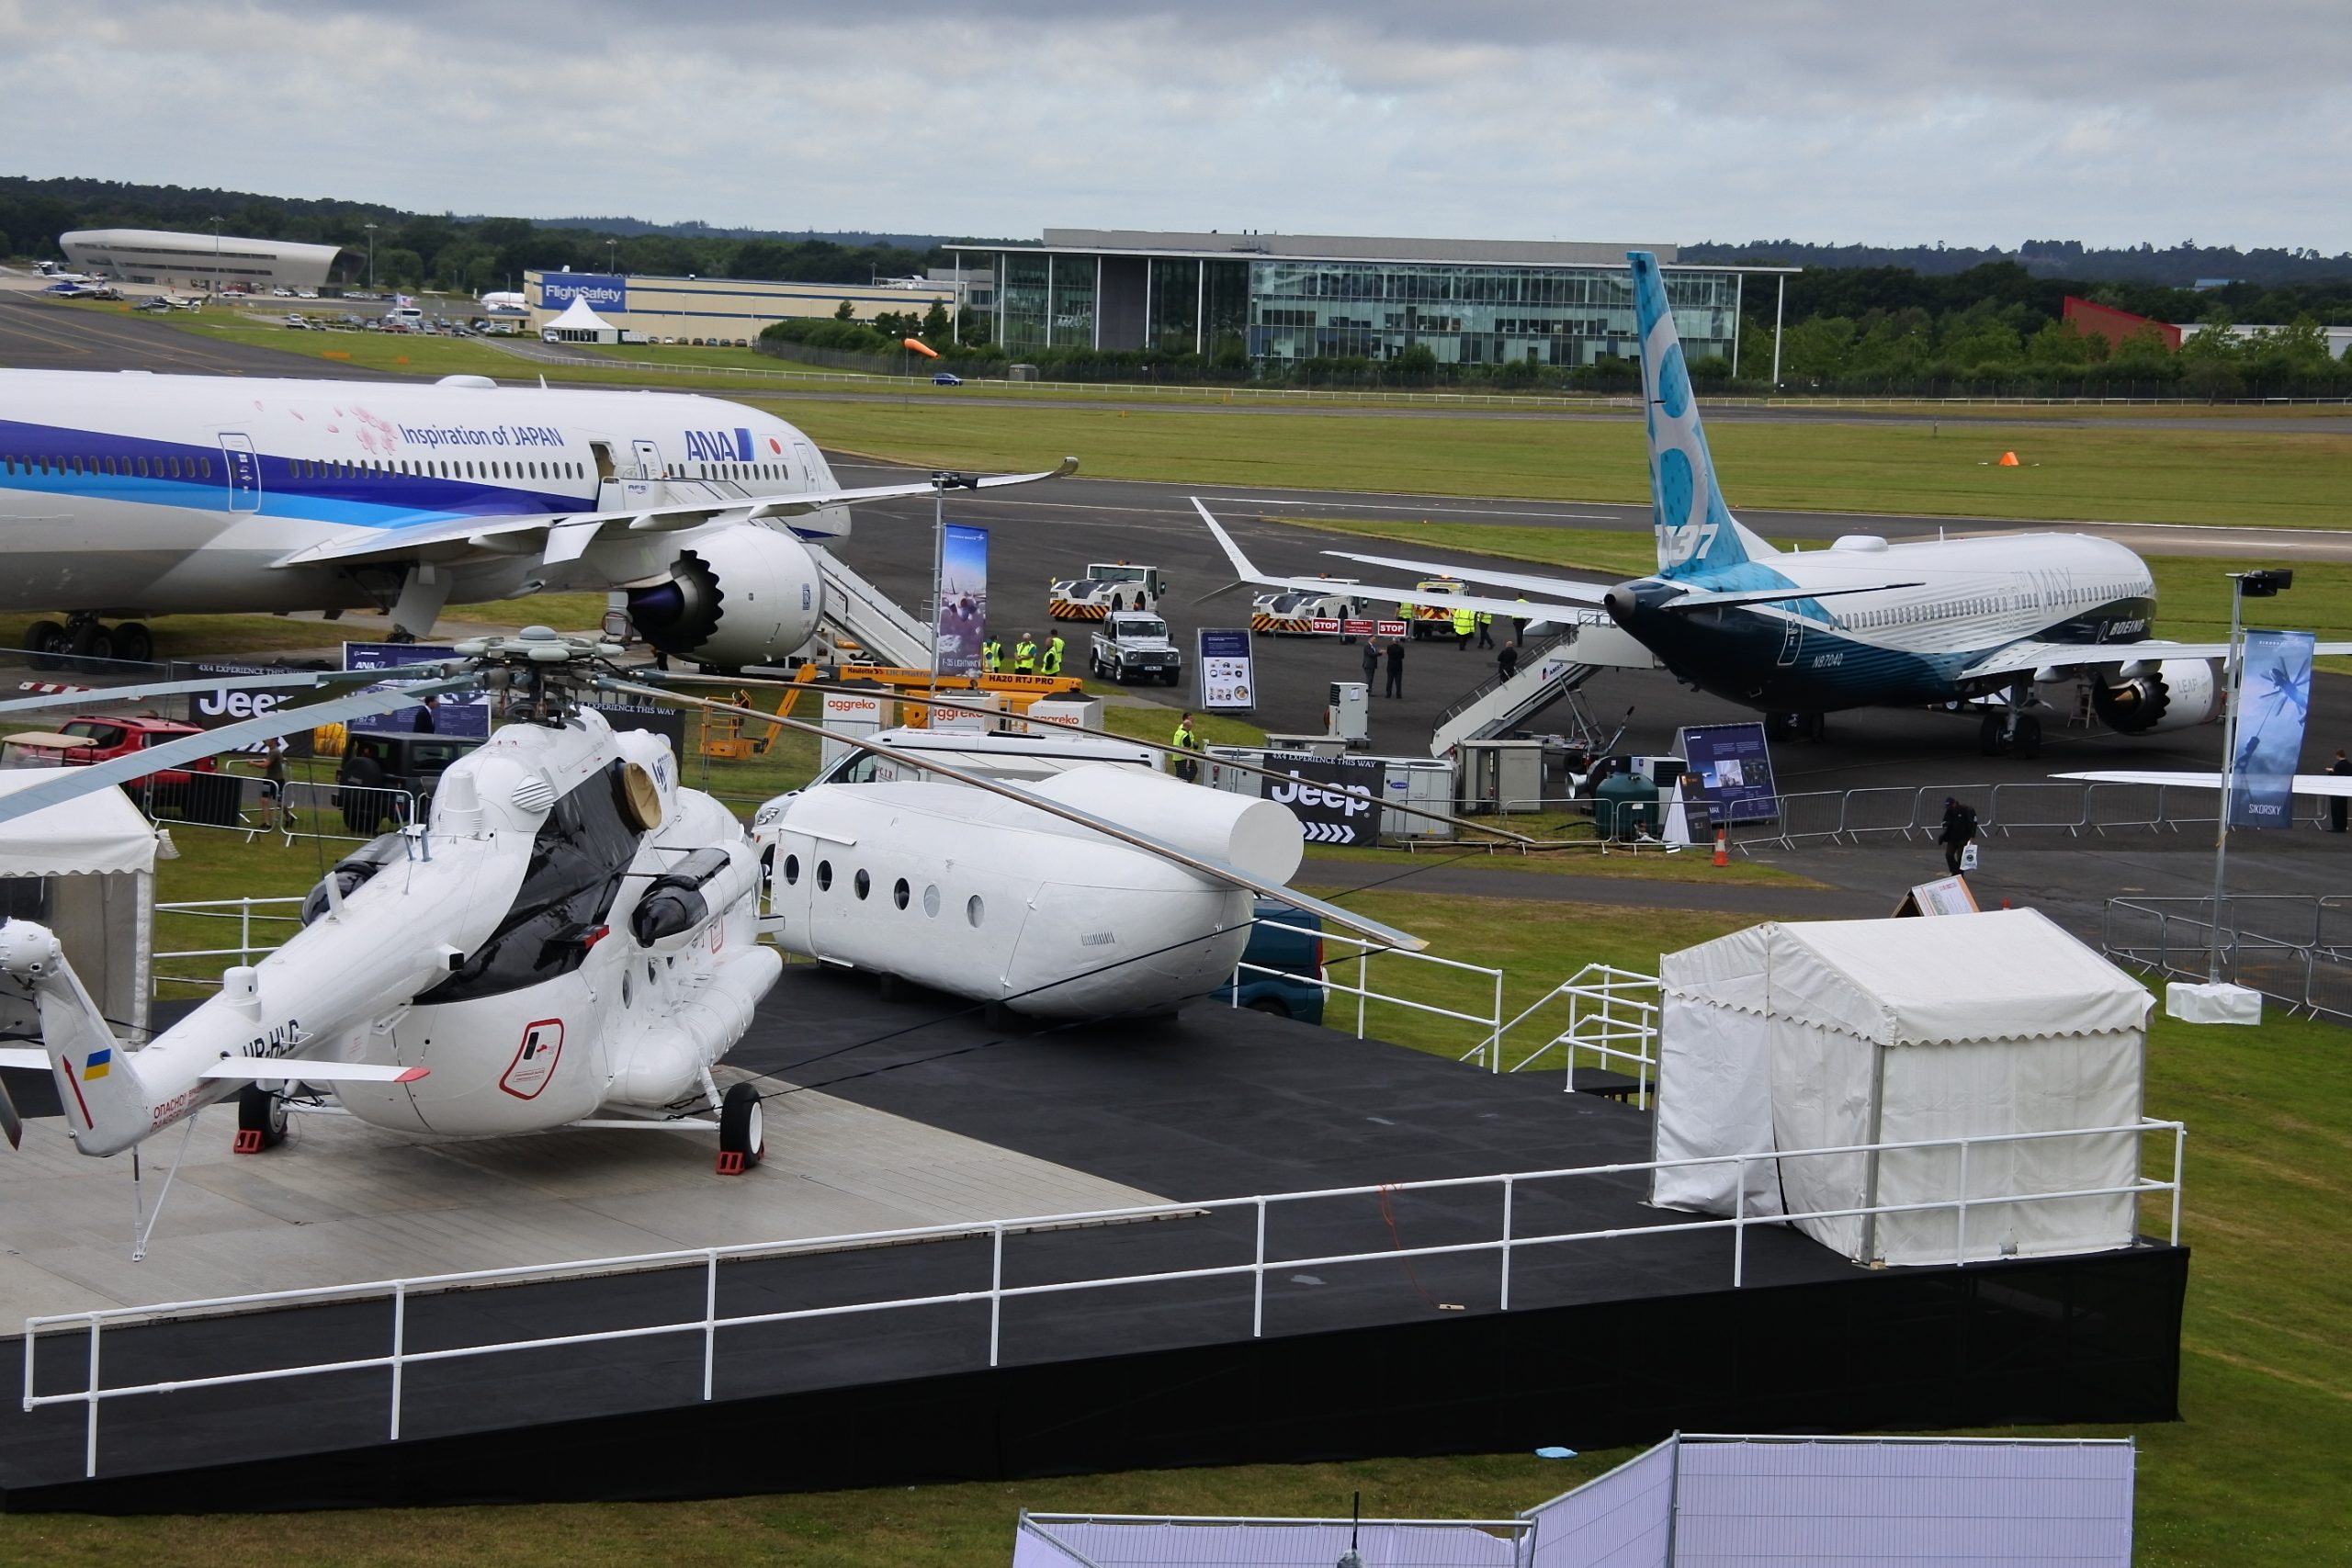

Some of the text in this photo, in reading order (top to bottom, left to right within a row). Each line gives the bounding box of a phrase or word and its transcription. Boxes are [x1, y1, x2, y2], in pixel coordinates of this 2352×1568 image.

[546, 285, 621, 302] FlightSafety
[398, 423, 565, 449] Inspiration of JAPAN
[684, 430, 738, 461] ANA
[1314, 621, 1338, 629] STOP
[2109, 618, 2145, 636] BOEING
[215, 665, 265, 676] EXPERIENCE
[355, 661, 375, 670] ANA
[989, 675, 1012, 683] HA20
[1015, 676, 1033, 684] RTJ
[2177, 678, 2197, 694] LEAP
[588, 702, 676, 716] EXPERIENCE THIS WAY
[828, 698, 876, 712] aggreko
[1033, 714, 1080, 724] reko
[1288, 755, 1336, 764] EXPERIENCE
[1337, 758, 1356, 767] THIS
[1272, 771, 1371, 817] Jeep
[2248, 803, 2281, 816] SIKORSKY
